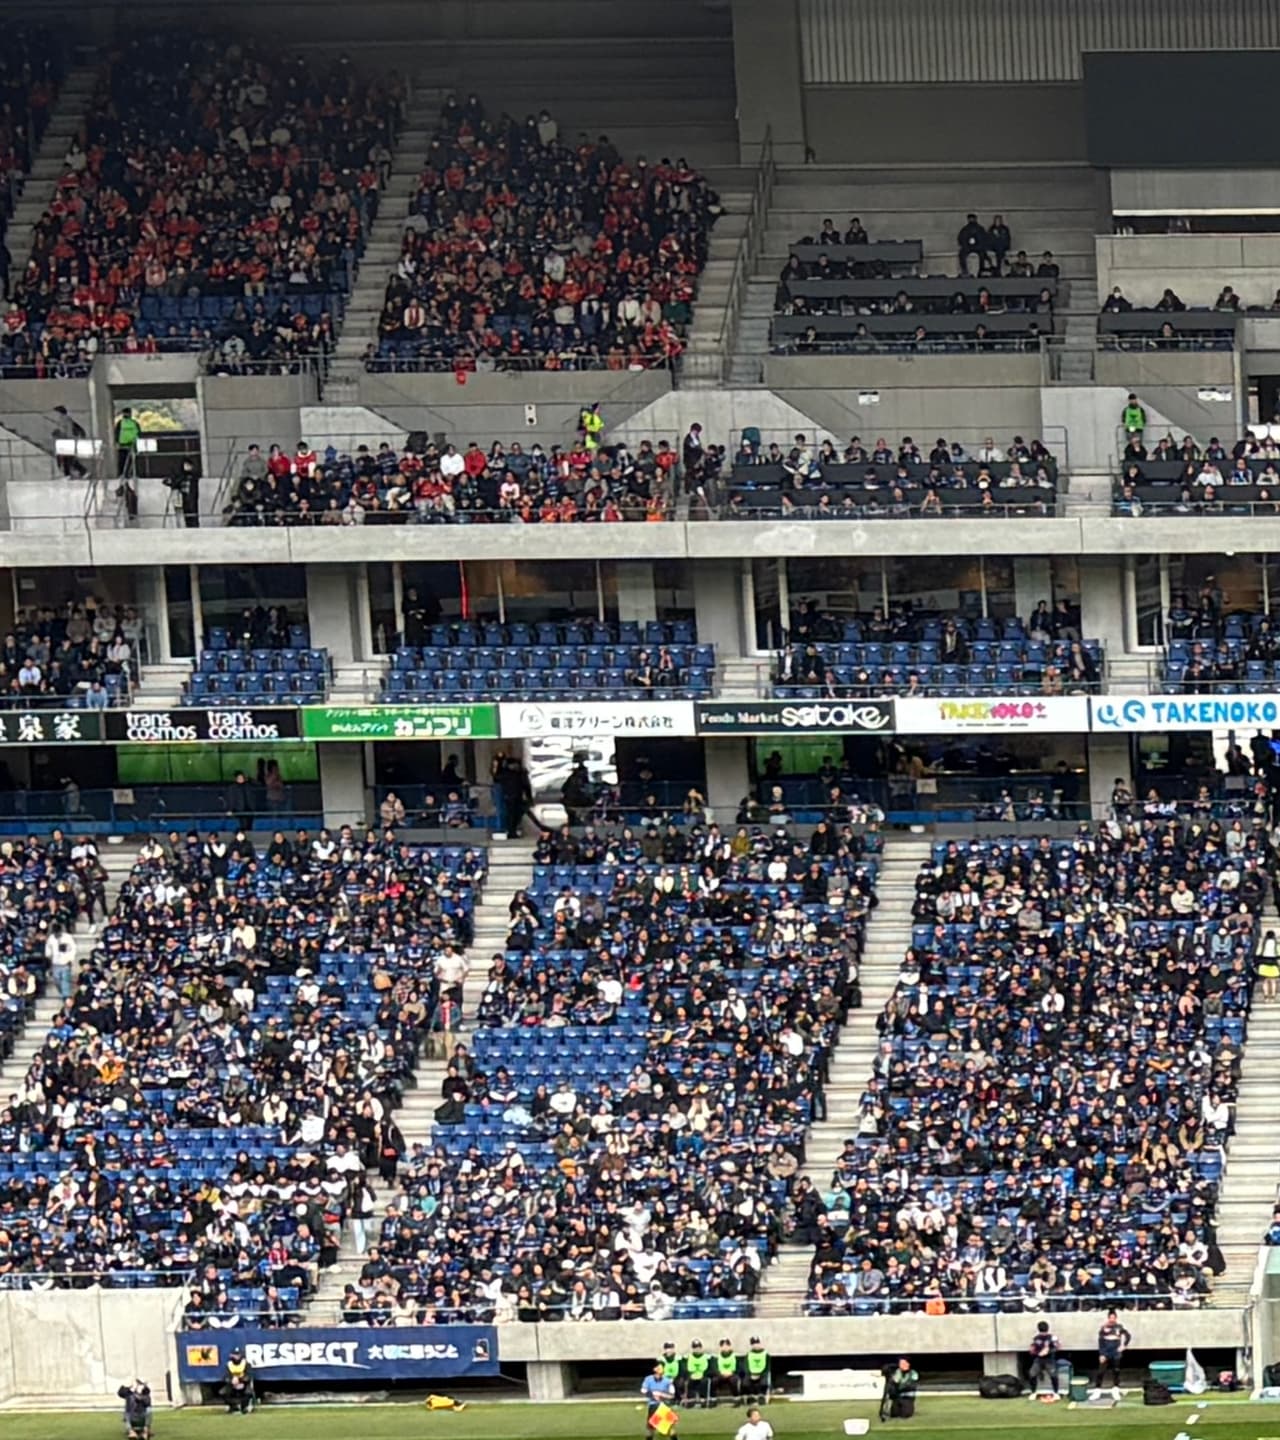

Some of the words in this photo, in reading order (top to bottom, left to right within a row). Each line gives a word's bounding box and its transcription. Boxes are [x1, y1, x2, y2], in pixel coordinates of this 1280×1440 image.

[126, 711, 171, 728] trans
[207, 710, 252, 727] trans
[781, 703, 890, 730] satake
[1151, 701, 1278, 723] TAKENOKO
[126, 725, 197, 741] cosmos
[208, 723, 279, 740] cosmos
[245, 1342, 360, 1367] RESPECT
